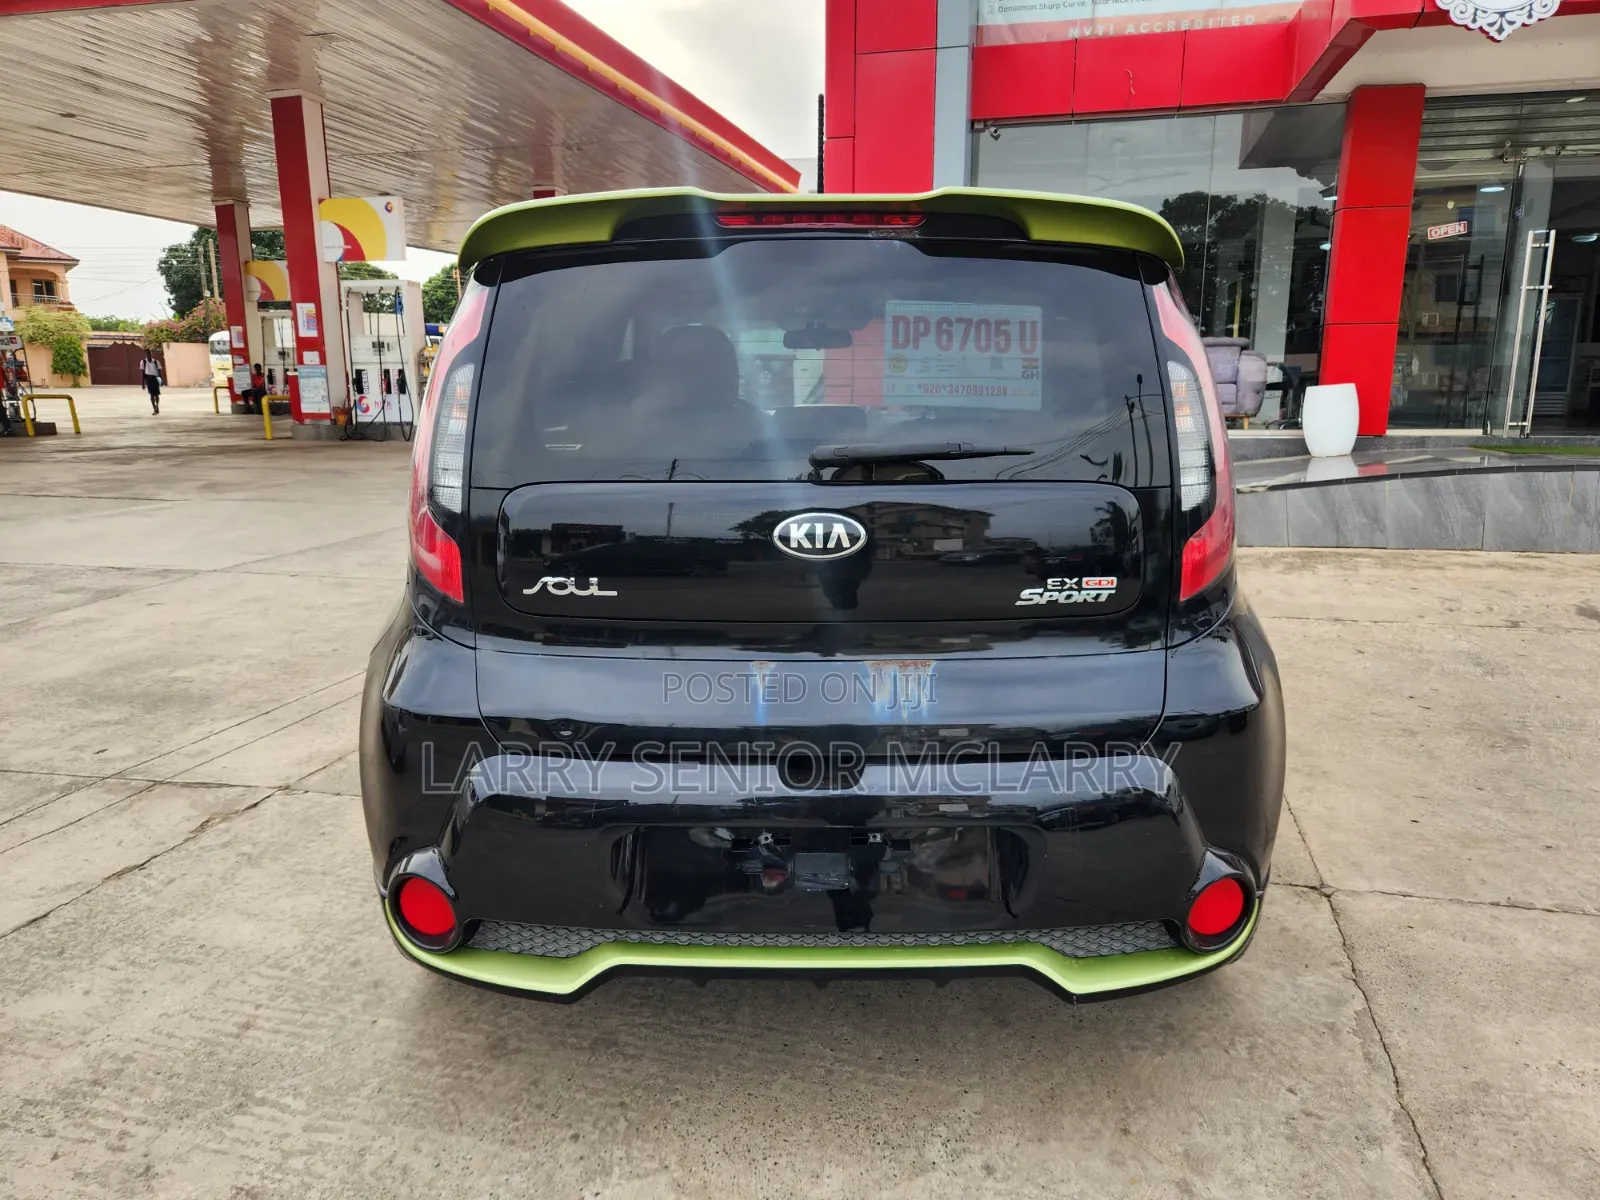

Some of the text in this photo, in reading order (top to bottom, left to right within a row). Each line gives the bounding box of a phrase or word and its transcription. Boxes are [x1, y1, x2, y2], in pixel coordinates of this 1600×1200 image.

[1039, 3, 1061, 11] Sharp
[1068, 15, 1256, 38] NVTI ACCREDITED
[1431, 223, 1465, 237] OPEN
[892, 315, 1038, 354] DP 6705 U
[1022, 370, 1039, 380] GH
[789, 523, 851, 549] KIA
[522, 576, 618, 597] SOUL
[1046, 577, 1114, 590] EX GDI
[1014, 588, 1116, 605] SPORT
